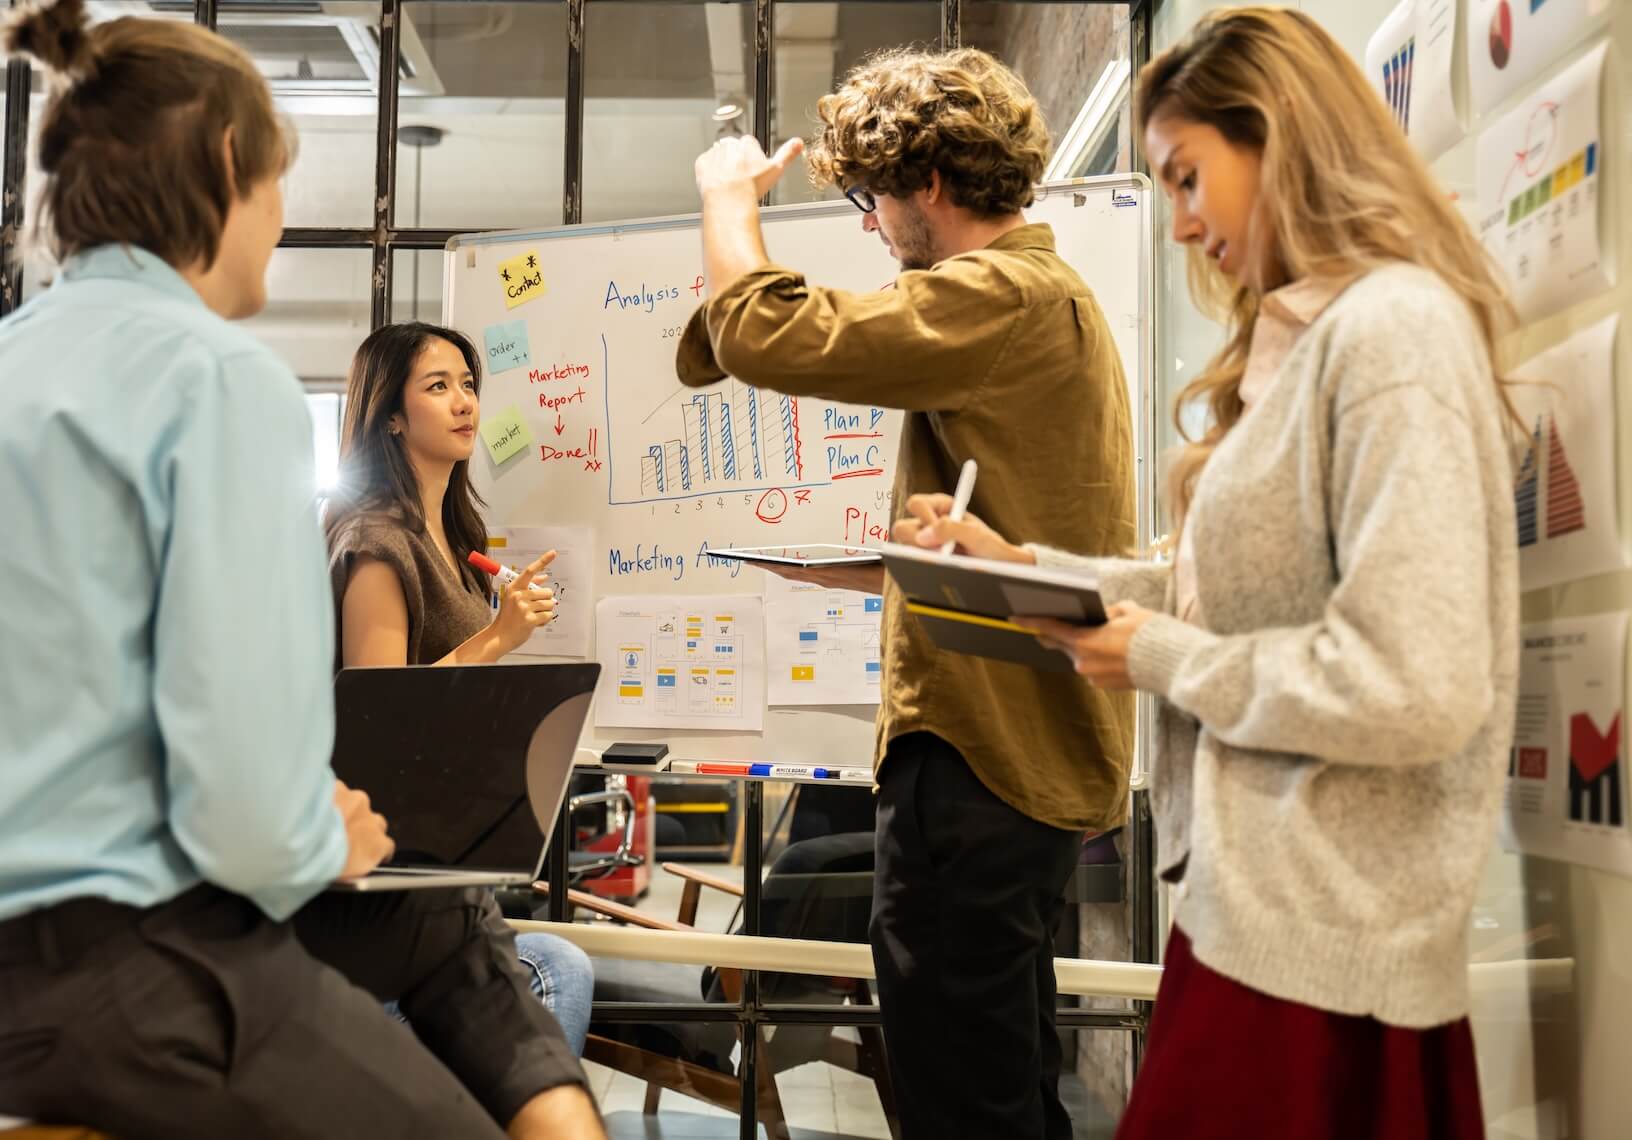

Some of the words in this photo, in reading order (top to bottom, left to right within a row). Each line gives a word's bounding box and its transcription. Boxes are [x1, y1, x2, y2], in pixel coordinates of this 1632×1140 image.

[507, 271, 542, 298] Contact
[604, 281, 679, 313] Analysis
[489, 342, 515, 358] order
[529, 363, 590, 384] Marketing
[539, 385, 586, 412] Report
[823, 407, 860, 431] Plan
[491, 423, 521, 451] market
[827, 444, 860, 474] Plan
[650, 505, 655, 516] 1
[674, 503, 681, 514] 2
[695, 499, 703, 511] 3
[716, 496, 725, 509] 4
[744, 494, 752, 505] 5
[766, 492, 778, 509] 6
[609, 543, 684, 581] Marketing
